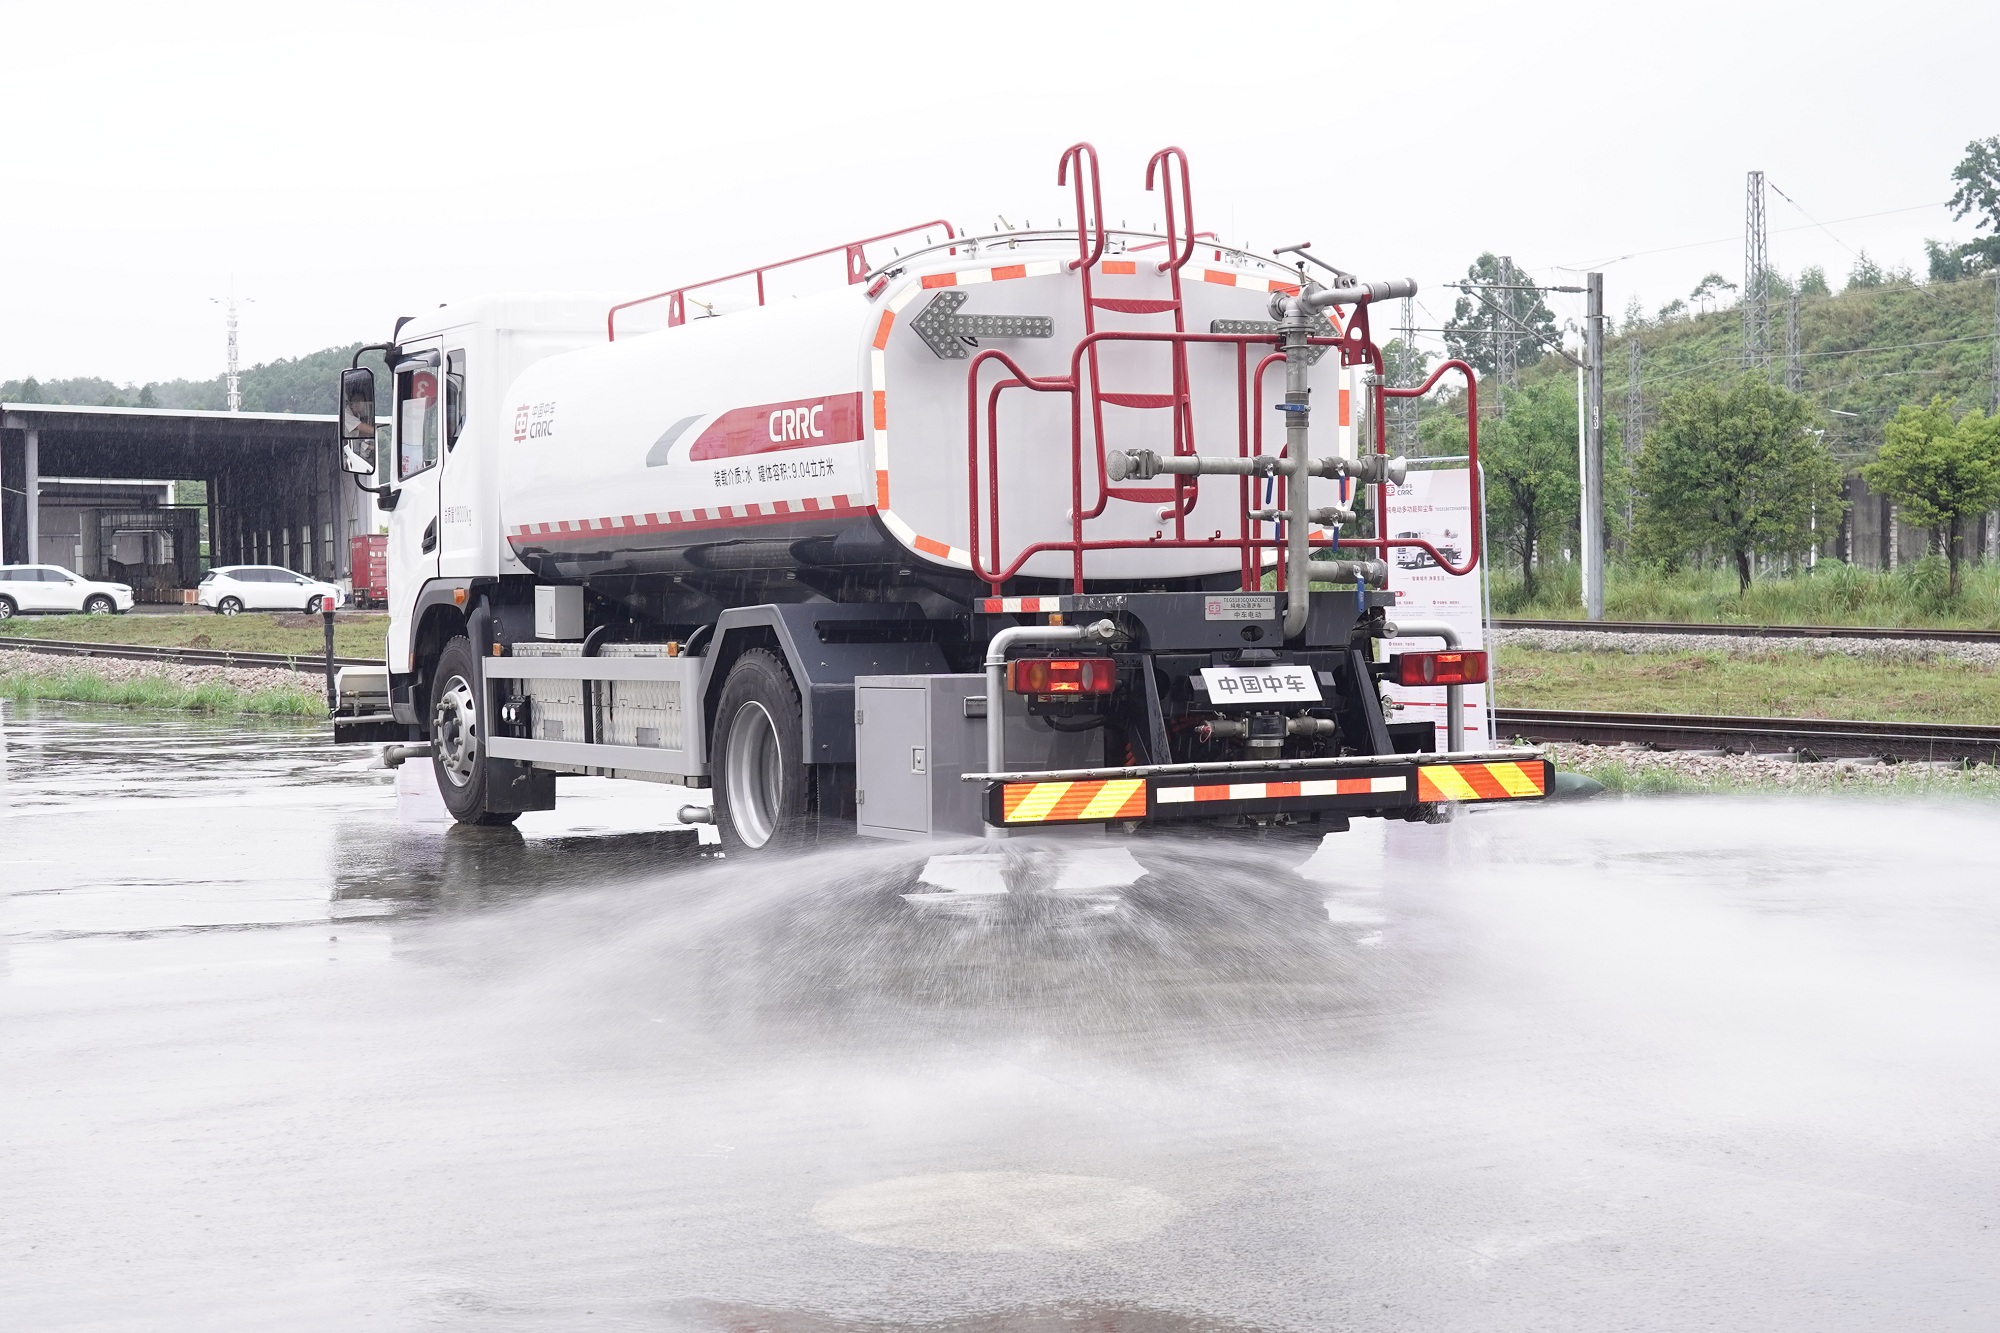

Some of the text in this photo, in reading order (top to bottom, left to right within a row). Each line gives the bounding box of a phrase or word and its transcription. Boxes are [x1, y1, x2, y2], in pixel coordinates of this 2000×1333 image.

[530, 420, 553, 439] CRRC
[769, 405, 823, 442] CRRC
[1217, 675, 1306, 694] 中国中车
